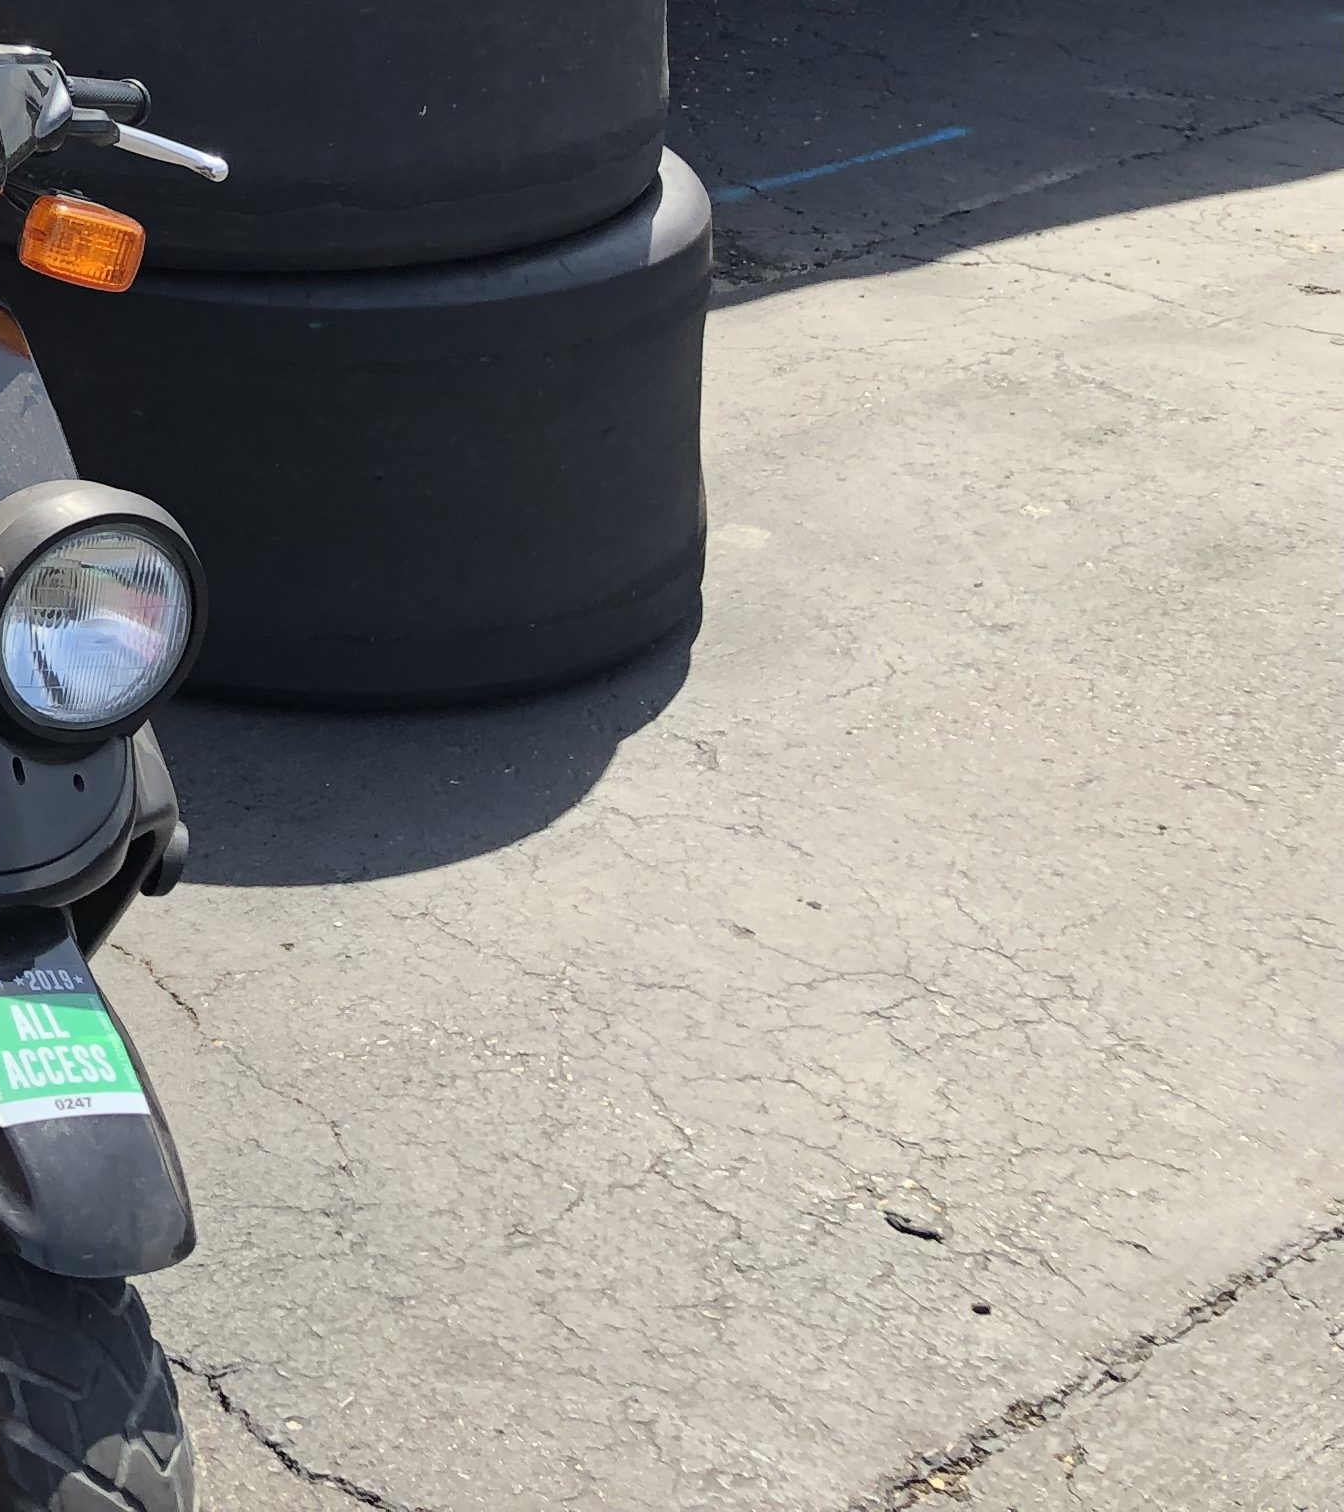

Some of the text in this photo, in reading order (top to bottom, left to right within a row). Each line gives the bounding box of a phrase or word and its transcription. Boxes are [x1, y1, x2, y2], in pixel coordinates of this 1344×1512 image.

[23, 969, 75, 991] 2019
[10, 1003, 70, 1042] ALL
[1, 1044, 116, 1090] ACCESS
[55, 1097, 92, 1111] 0247
